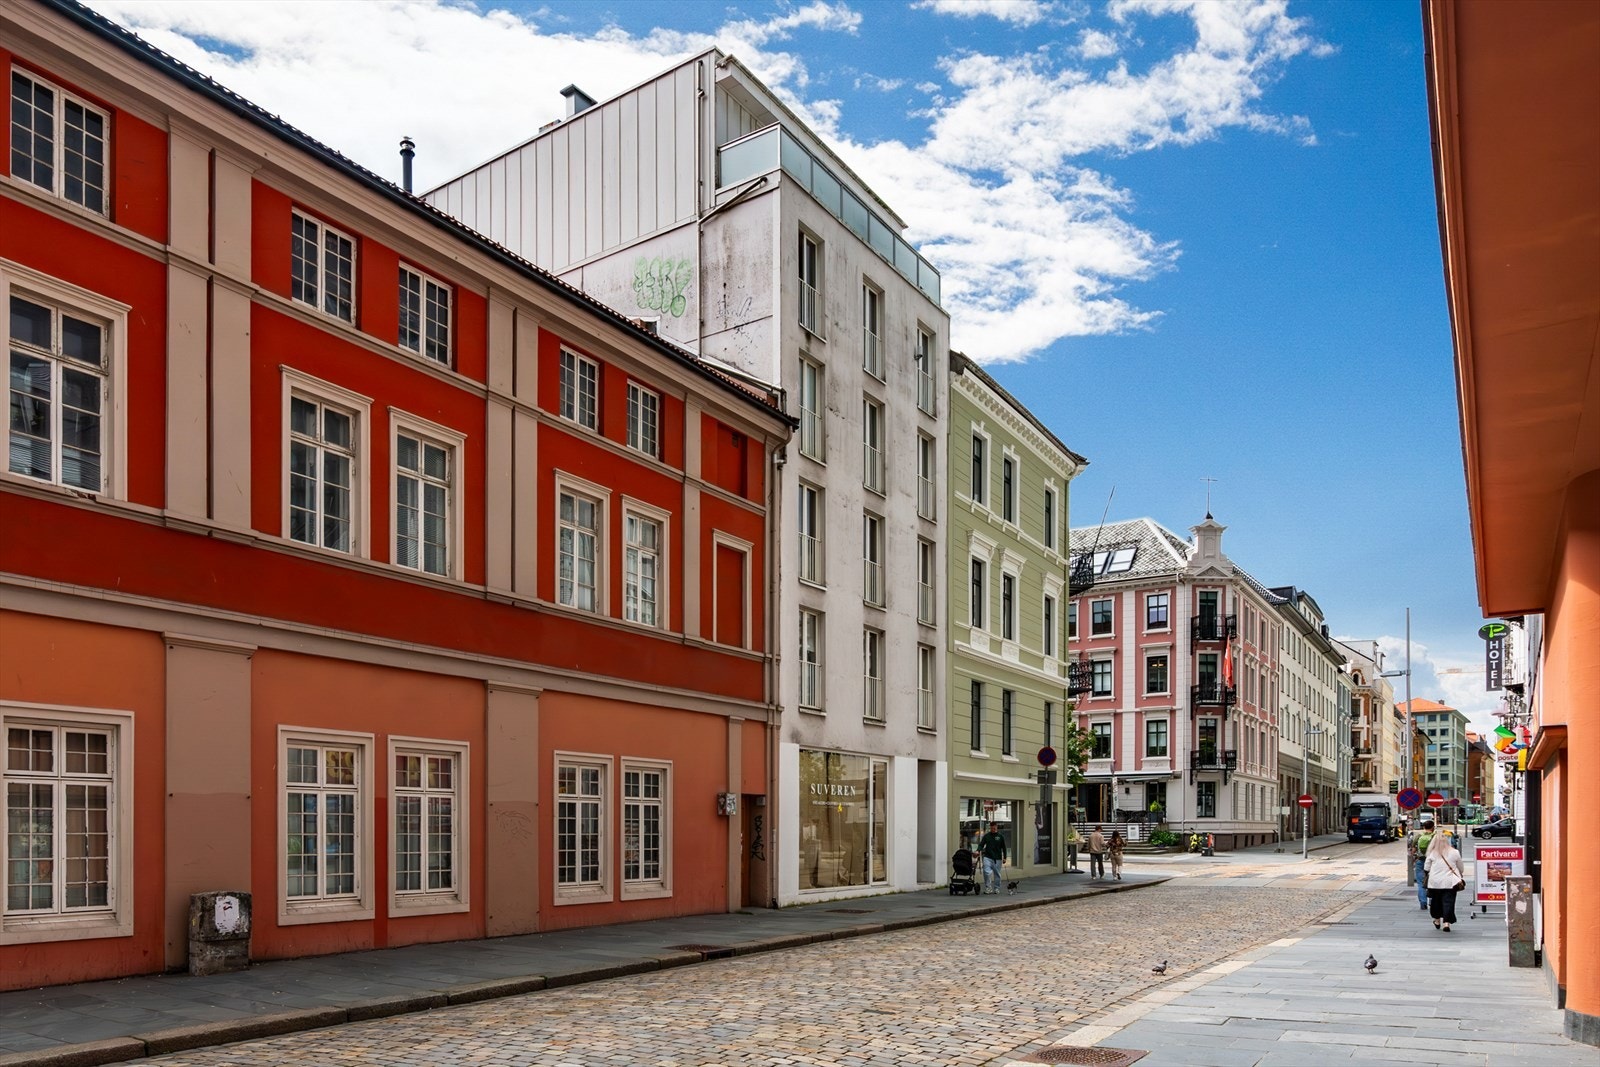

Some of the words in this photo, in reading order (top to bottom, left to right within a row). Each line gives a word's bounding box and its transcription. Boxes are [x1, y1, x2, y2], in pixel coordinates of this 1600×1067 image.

[1489, 640, 1500, 689] HOTEL
[810, 783, 856, 796] SUVEREN
[1480, 850, 1519, 858] Partivare!
